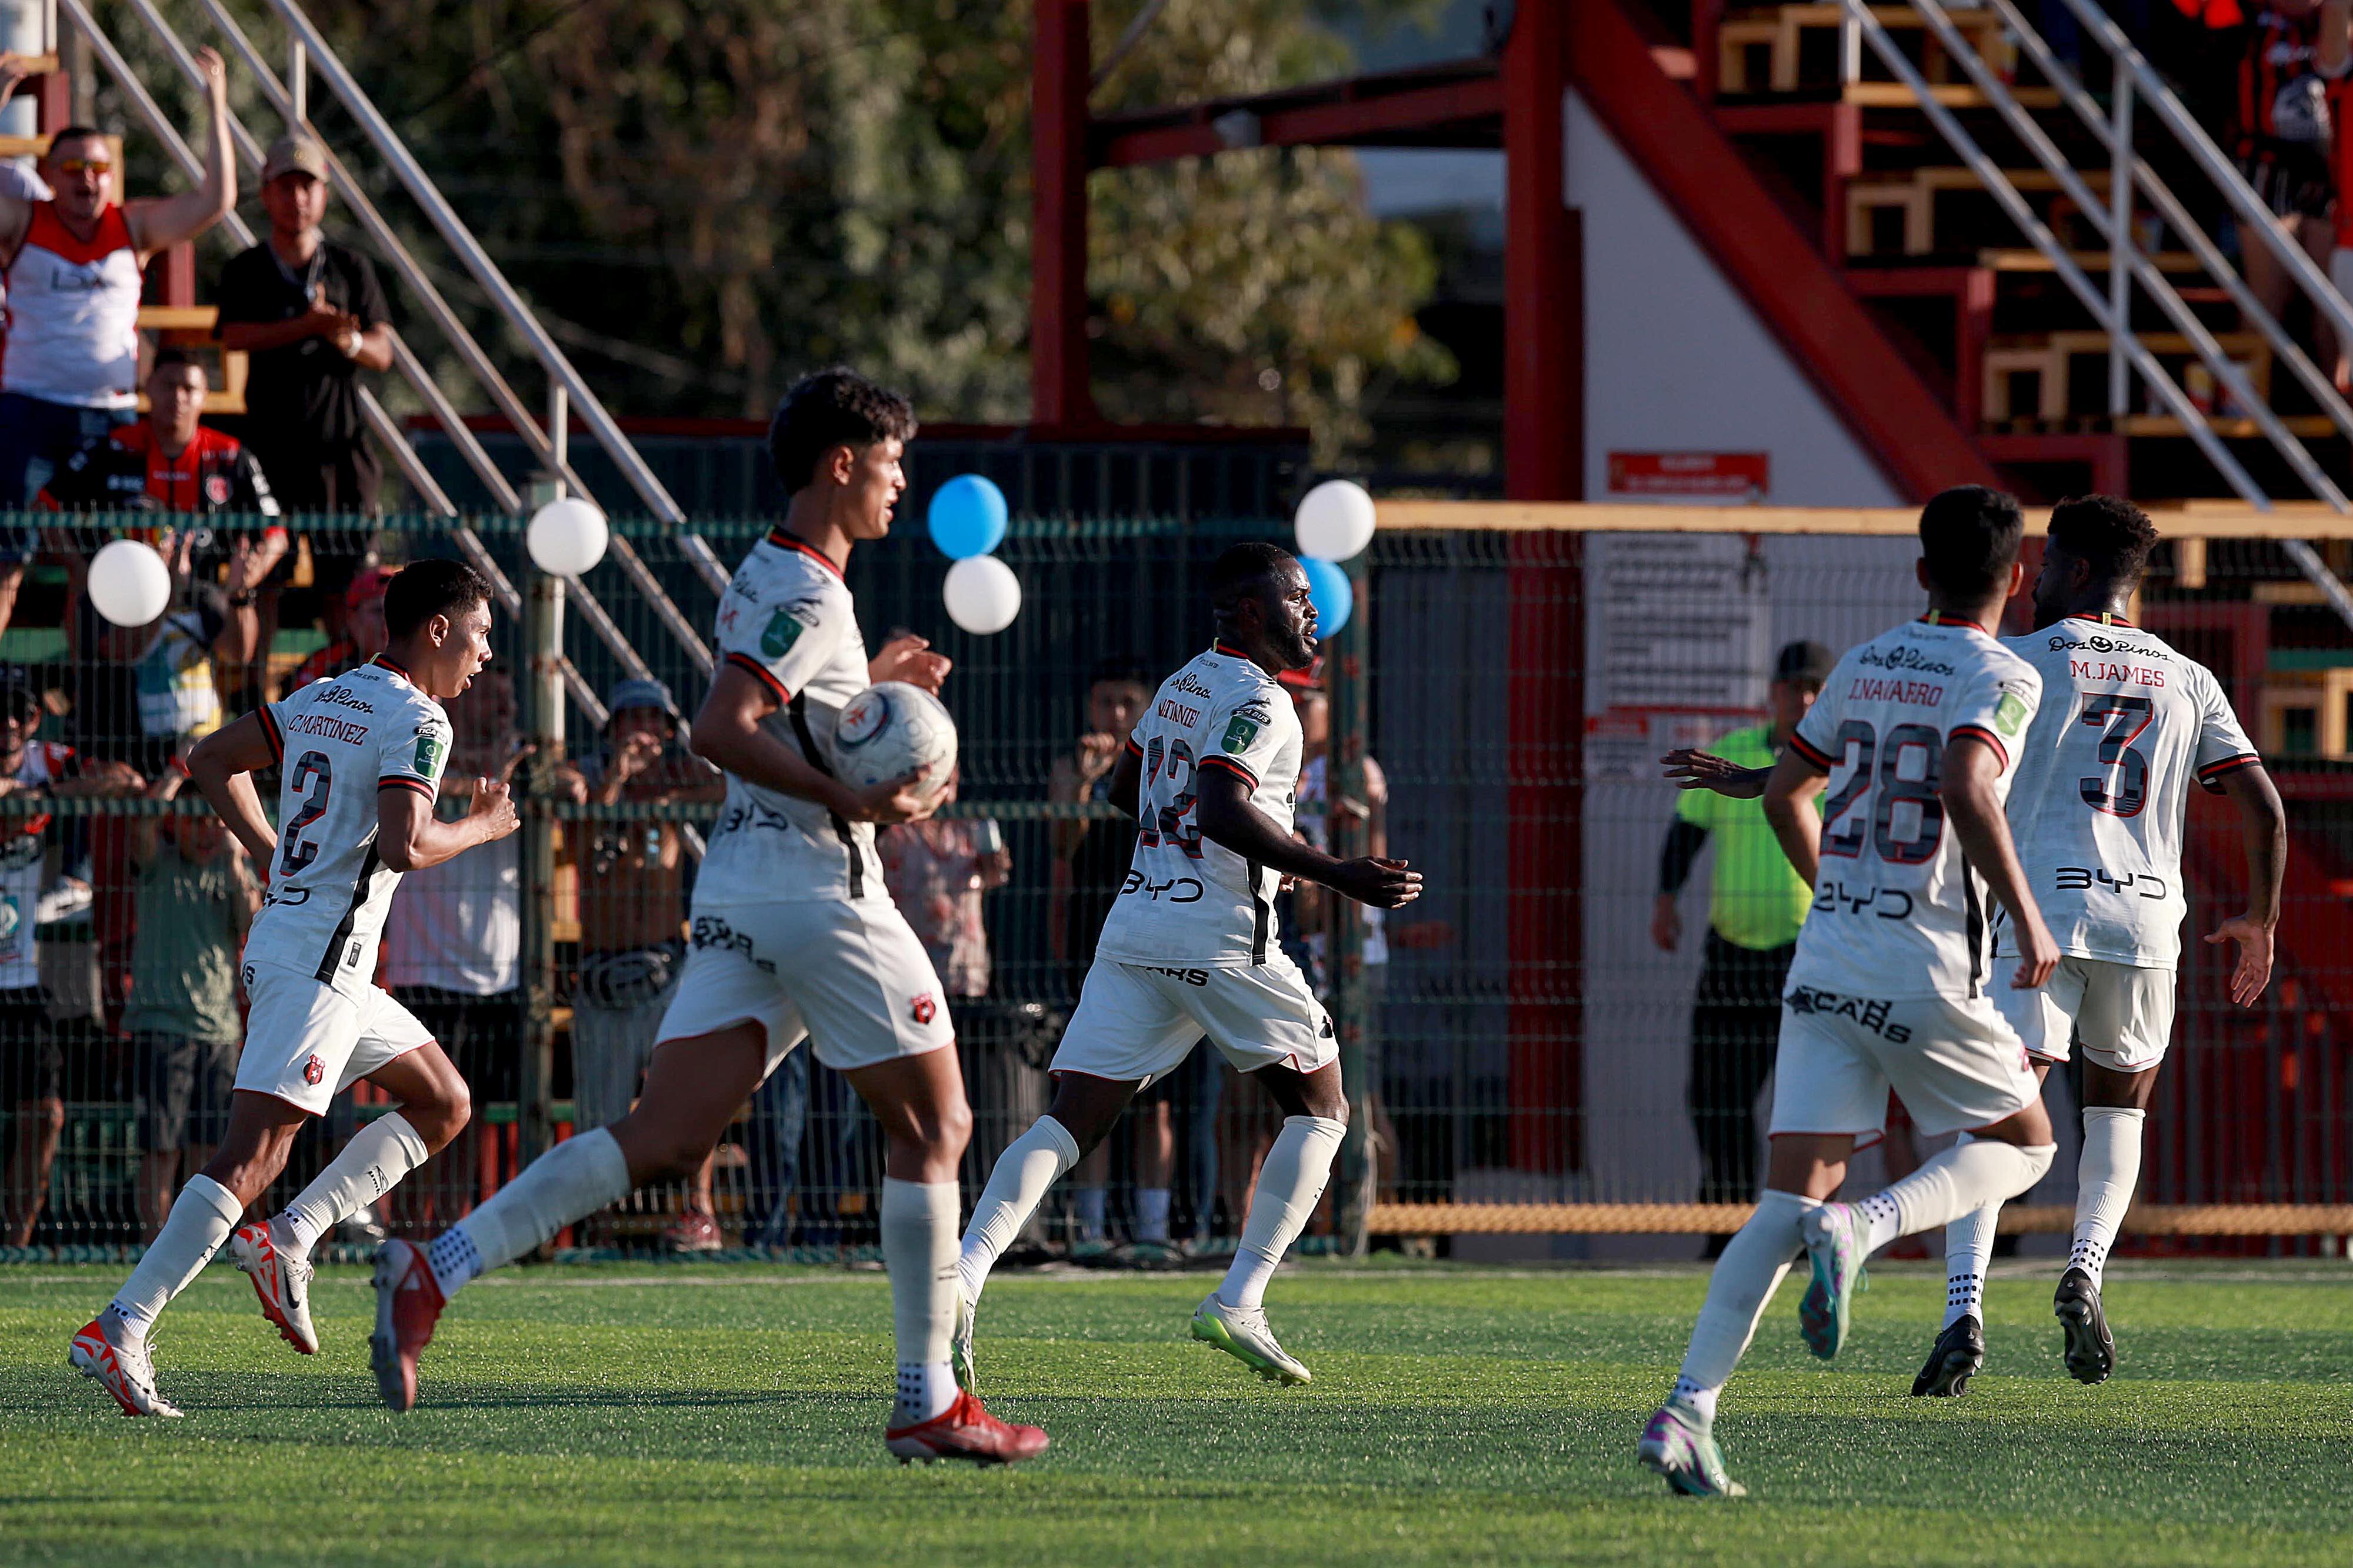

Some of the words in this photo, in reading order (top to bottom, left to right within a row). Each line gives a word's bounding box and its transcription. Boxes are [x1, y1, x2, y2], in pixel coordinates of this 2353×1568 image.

[1905, 648, 1956, 676] Pinos
[2049, 636, 2090, 652] Dos
[2114, 640, 2175, 663] Pinos
[2070, 660, 2165, 688] M.JAMES
[334, 688, 374, 714] Pinos
[288, 714, 369, 746] C.MARTÍNEZ
[418, 728, 436, 736] TICA
[2080, 692, 2154, 818] 3
[1819, 719, 1945, 865] 28
[279, 750, 332, 877] 2
[1119, 869, 1204, 903] BYD
[2056, 866, 2167, 900] BYD
[1143, 966, 1209, 987] ARS
